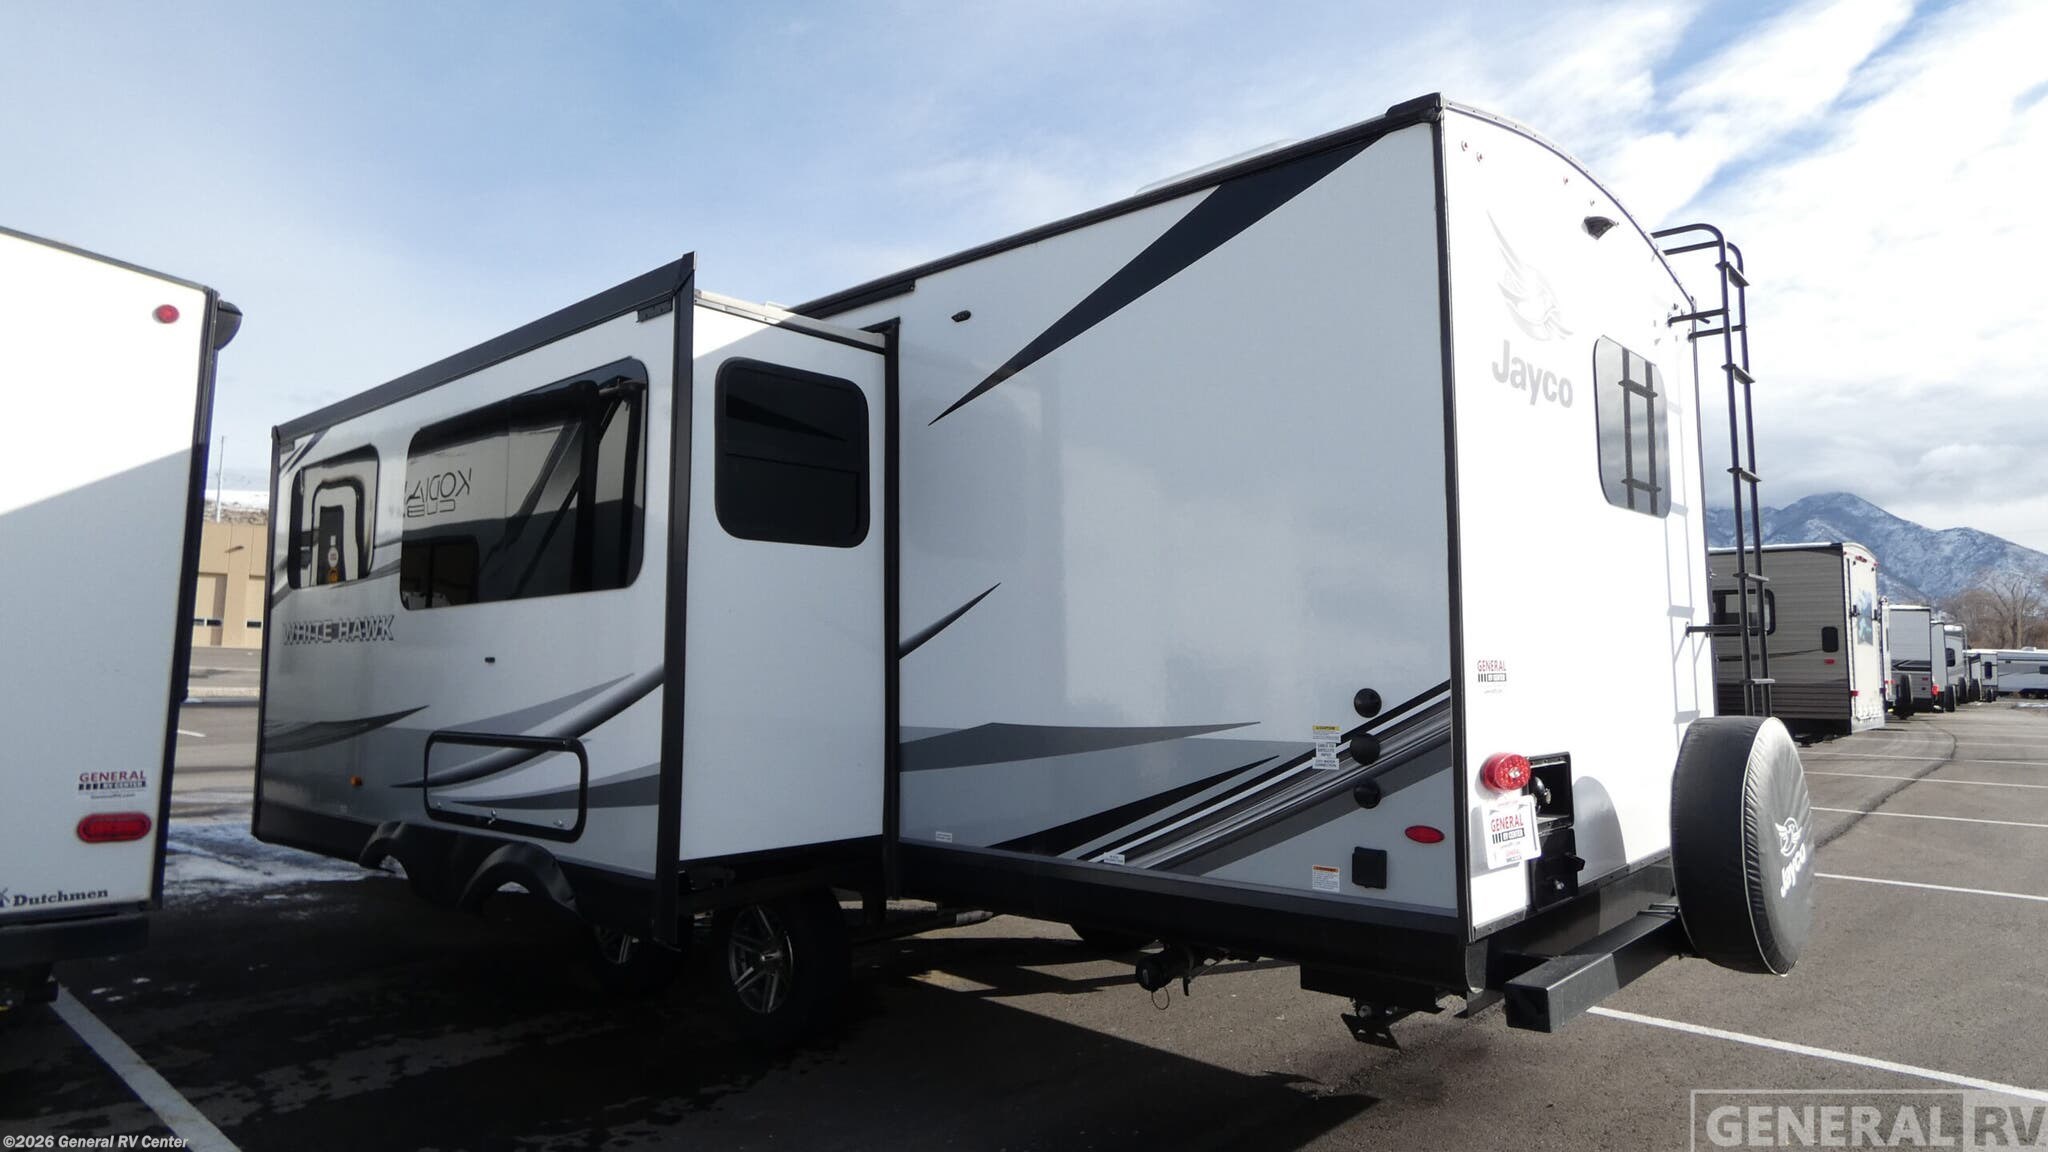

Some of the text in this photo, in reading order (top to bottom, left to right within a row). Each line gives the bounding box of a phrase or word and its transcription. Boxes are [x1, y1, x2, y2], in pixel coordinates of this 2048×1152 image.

[1492, 339, 1574, 408] Jayco
[283, 615, 395, 646] WHITE HAWK
[1477, 659, 1506, 672] GENERAL
[79, 770, 145, 782] GENERAL
[1490, 814, 1524, 832] GENERAL
[1780, 843, 1806, 898] Jayco
[12, 889, 108, 907] Dutchmen
